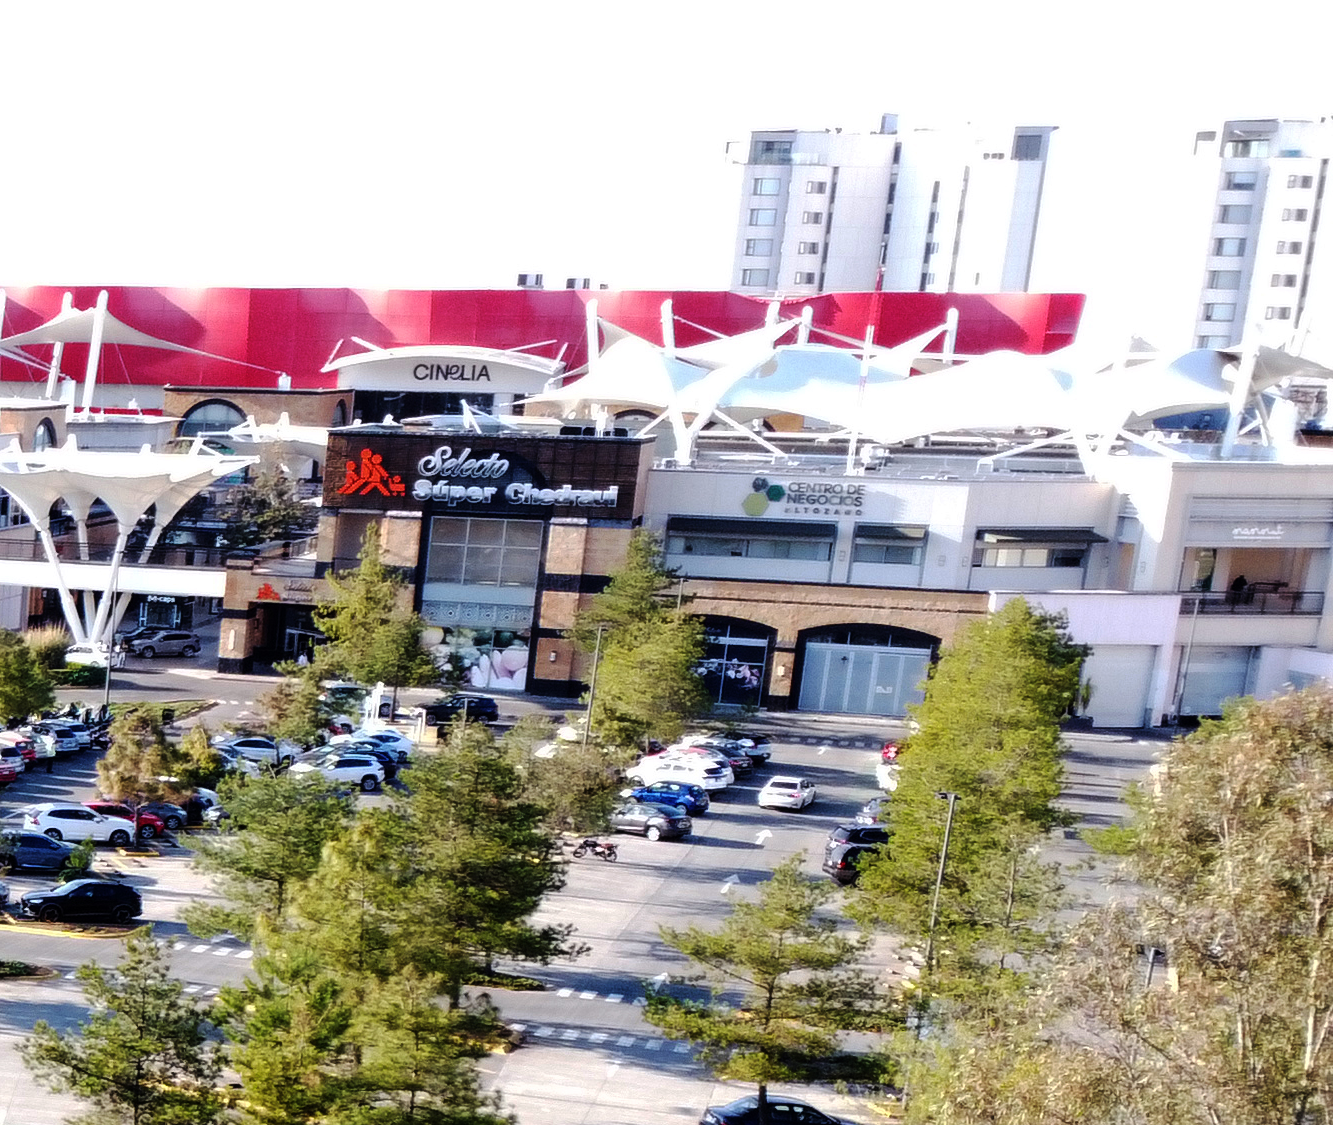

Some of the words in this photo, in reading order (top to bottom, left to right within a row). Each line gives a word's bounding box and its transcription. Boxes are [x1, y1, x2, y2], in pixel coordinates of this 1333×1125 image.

[417, 445, 510, 479] Selecto
[412, 479, 498, 505] Súper
[505, 482, 619, 508] Chedraui
[788, 481, 844, 495] CENTRO
[847, 484, 866, 496] DE
[786, 493, 863, 507] NEGOCIOS
